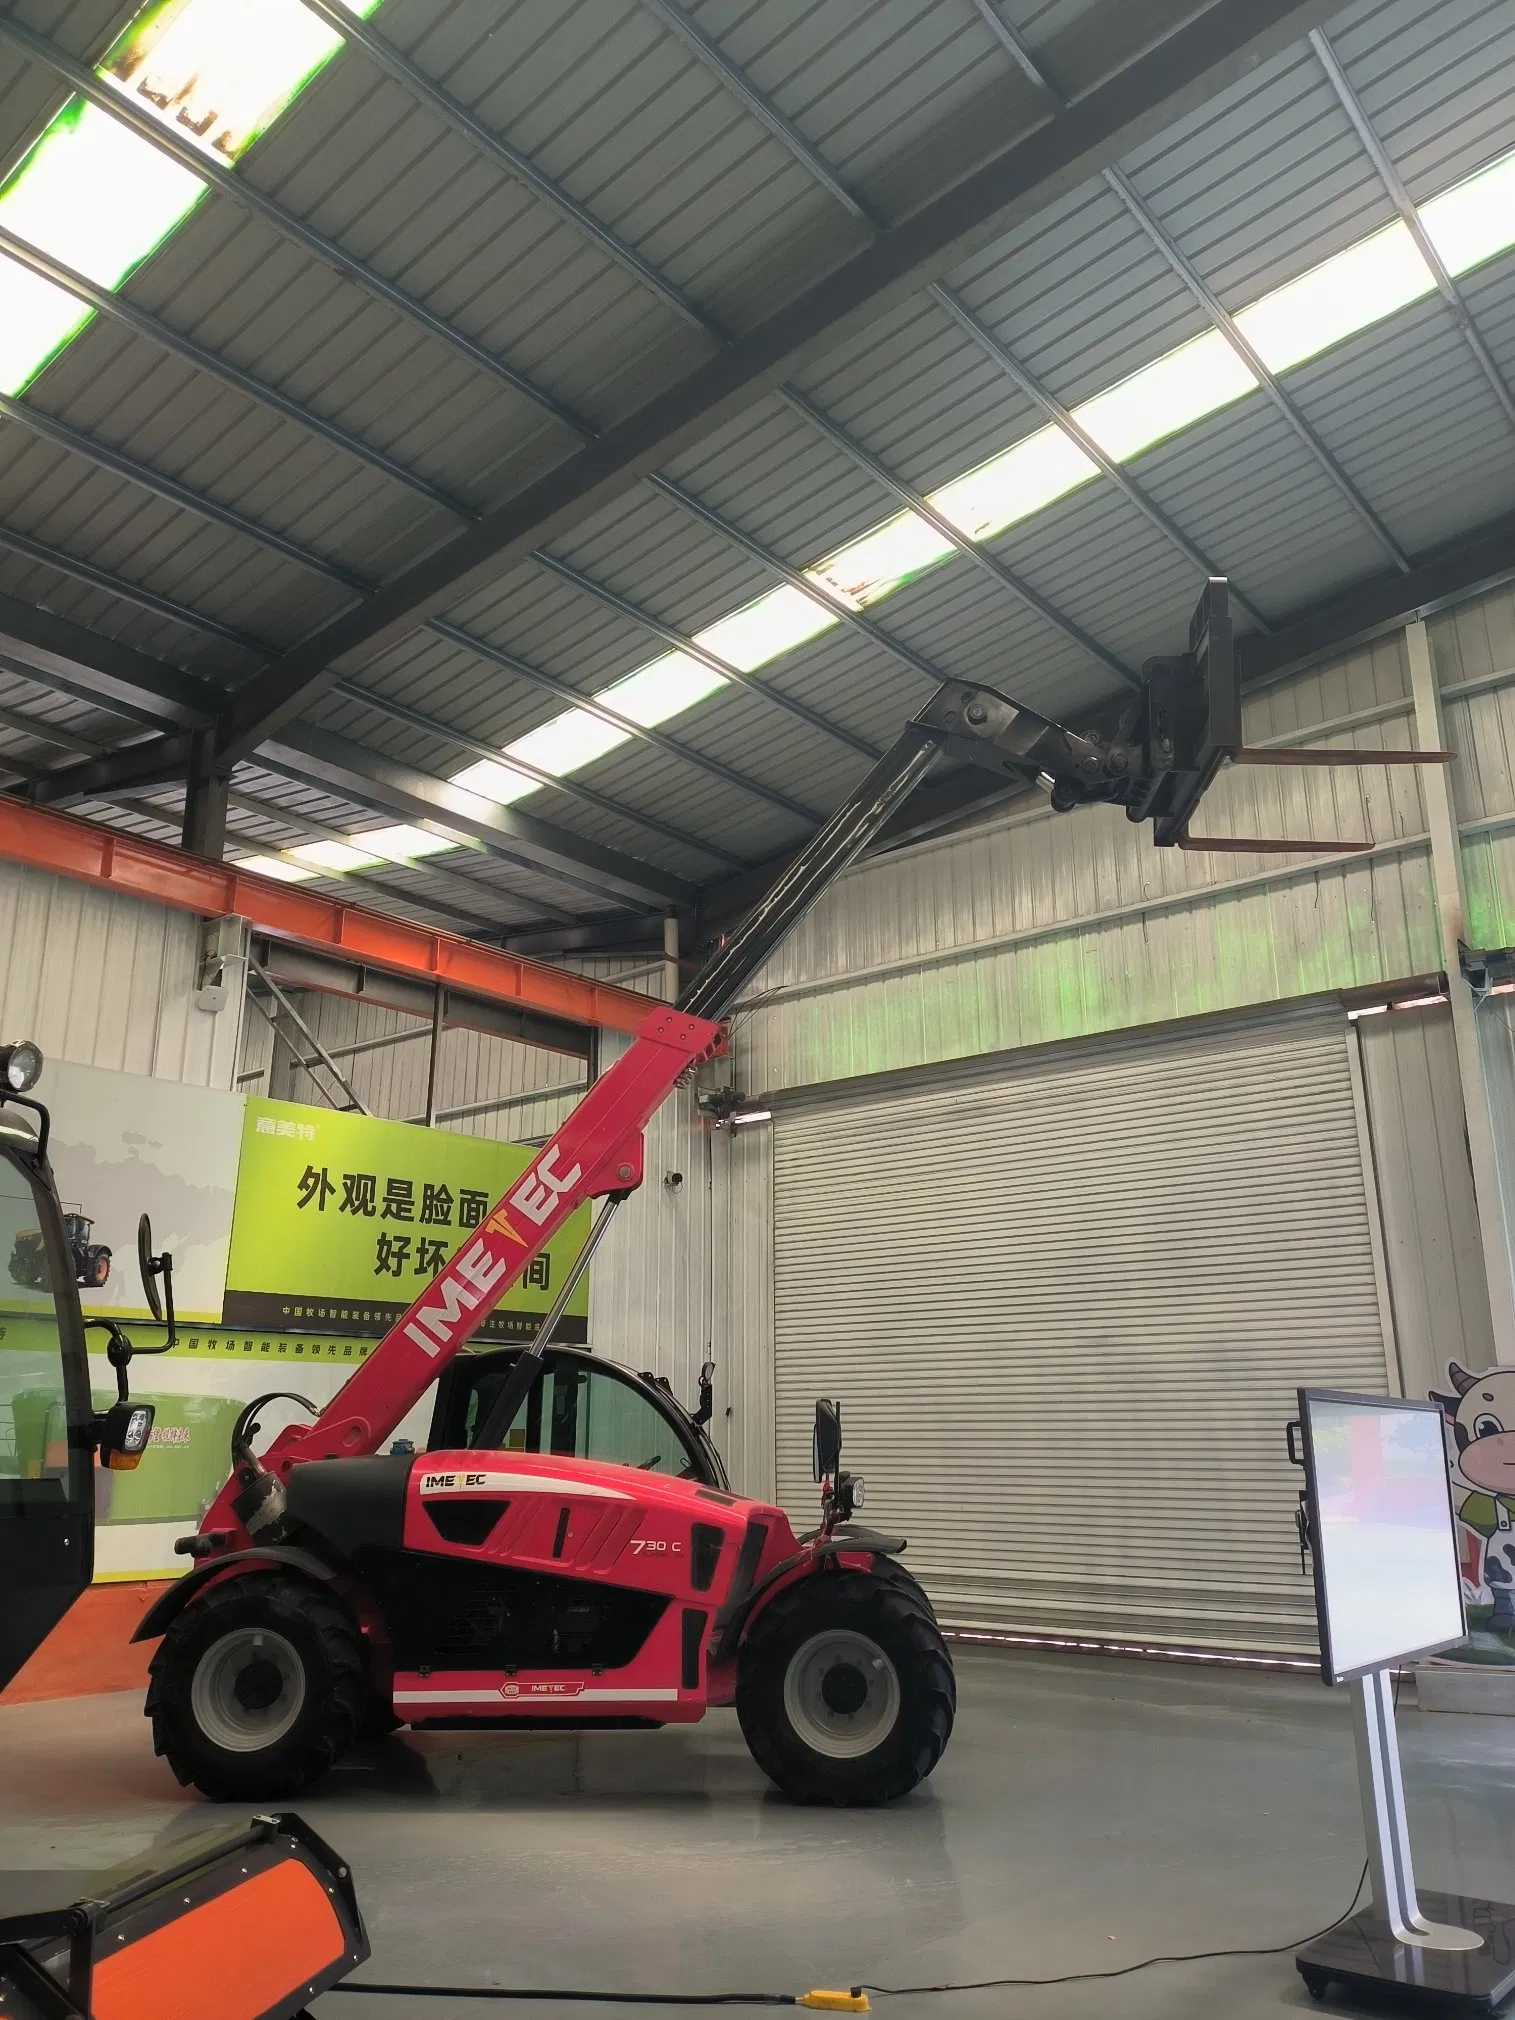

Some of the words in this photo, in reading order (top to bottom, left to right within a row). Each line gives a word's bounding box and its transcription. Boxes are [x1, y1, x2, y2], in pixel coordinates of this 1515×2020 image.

[296, 1164, 489, 1229] 外观是脸面
[630, 1539, 667, 1555] 730
[671, 1542, 682, 1552] C
